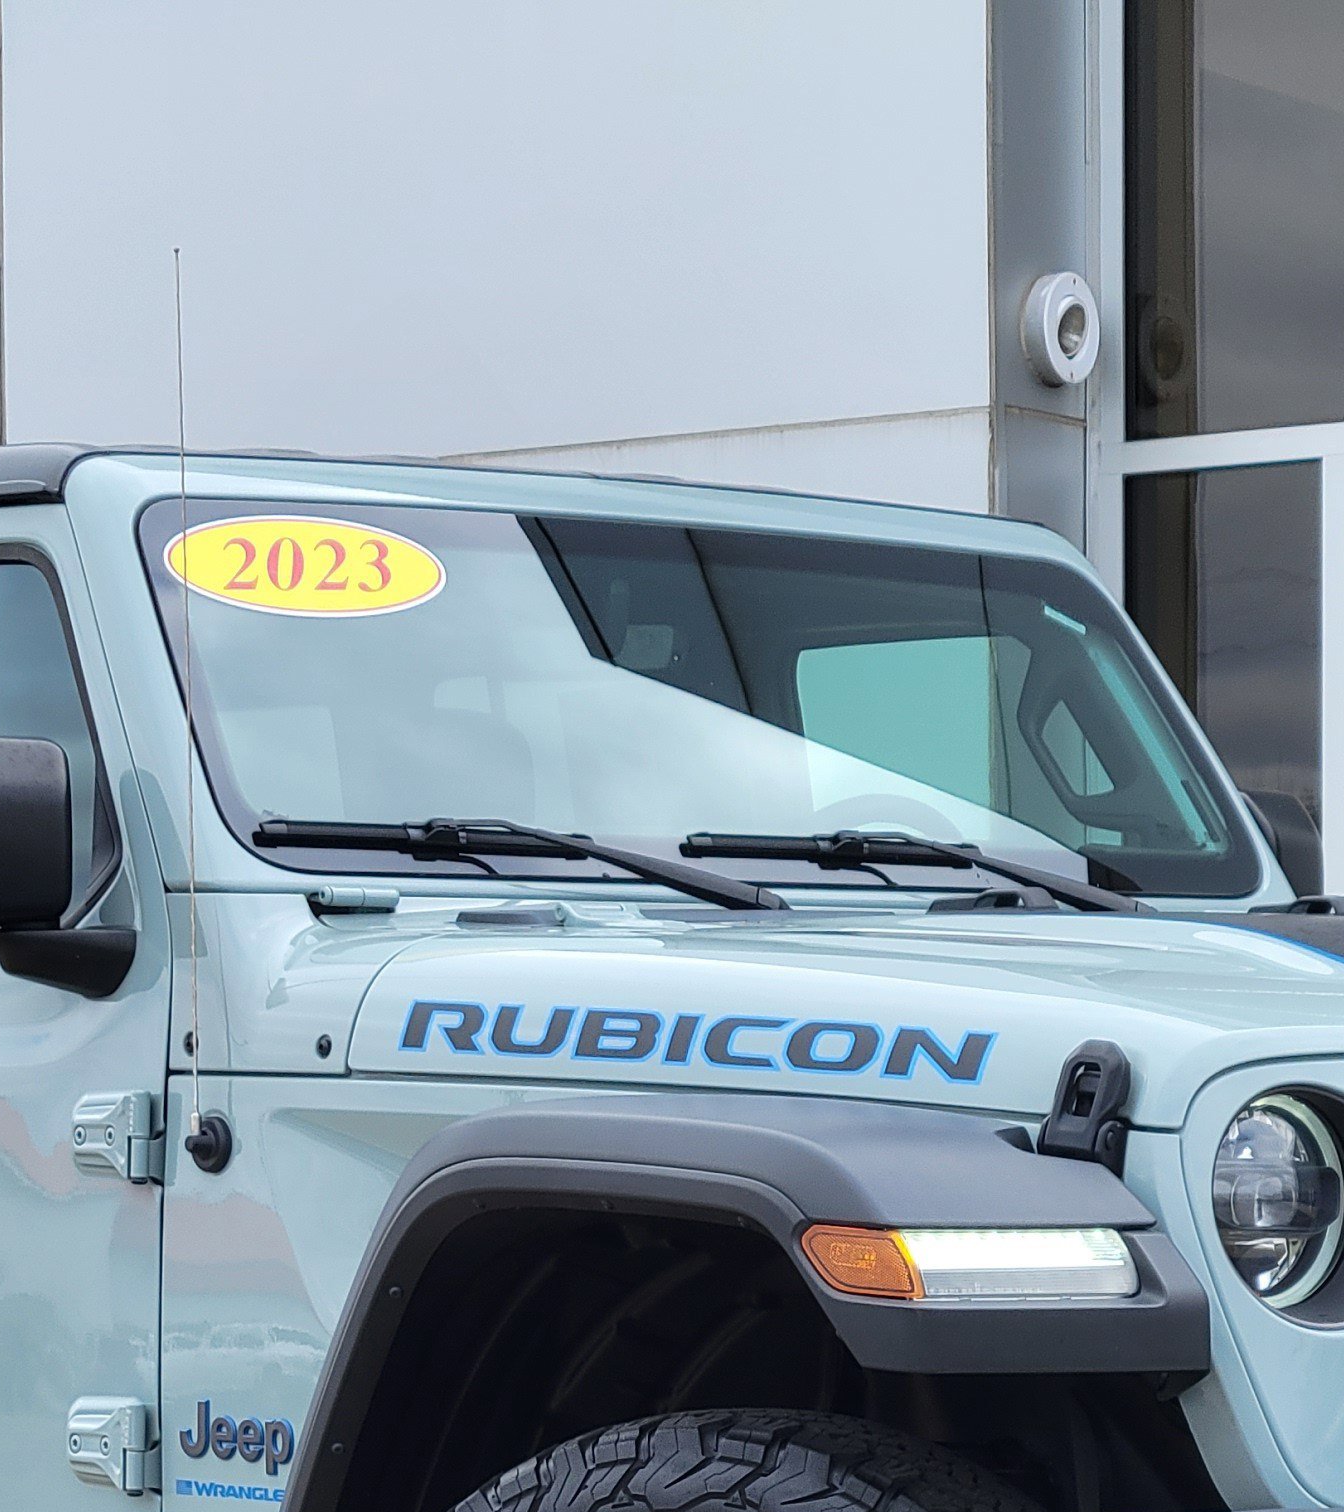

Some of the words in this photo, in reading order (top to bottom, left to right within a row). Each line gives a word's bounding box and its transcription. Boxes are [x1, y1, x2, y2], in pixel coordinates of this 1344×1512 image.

[221, 535, 393, 593] 2023
[398, 998, 1001, 1087] RUBICON
[179, 1399, 295, 1476] Jeep
[193, 1480, 286, 1503] WRANGLE
